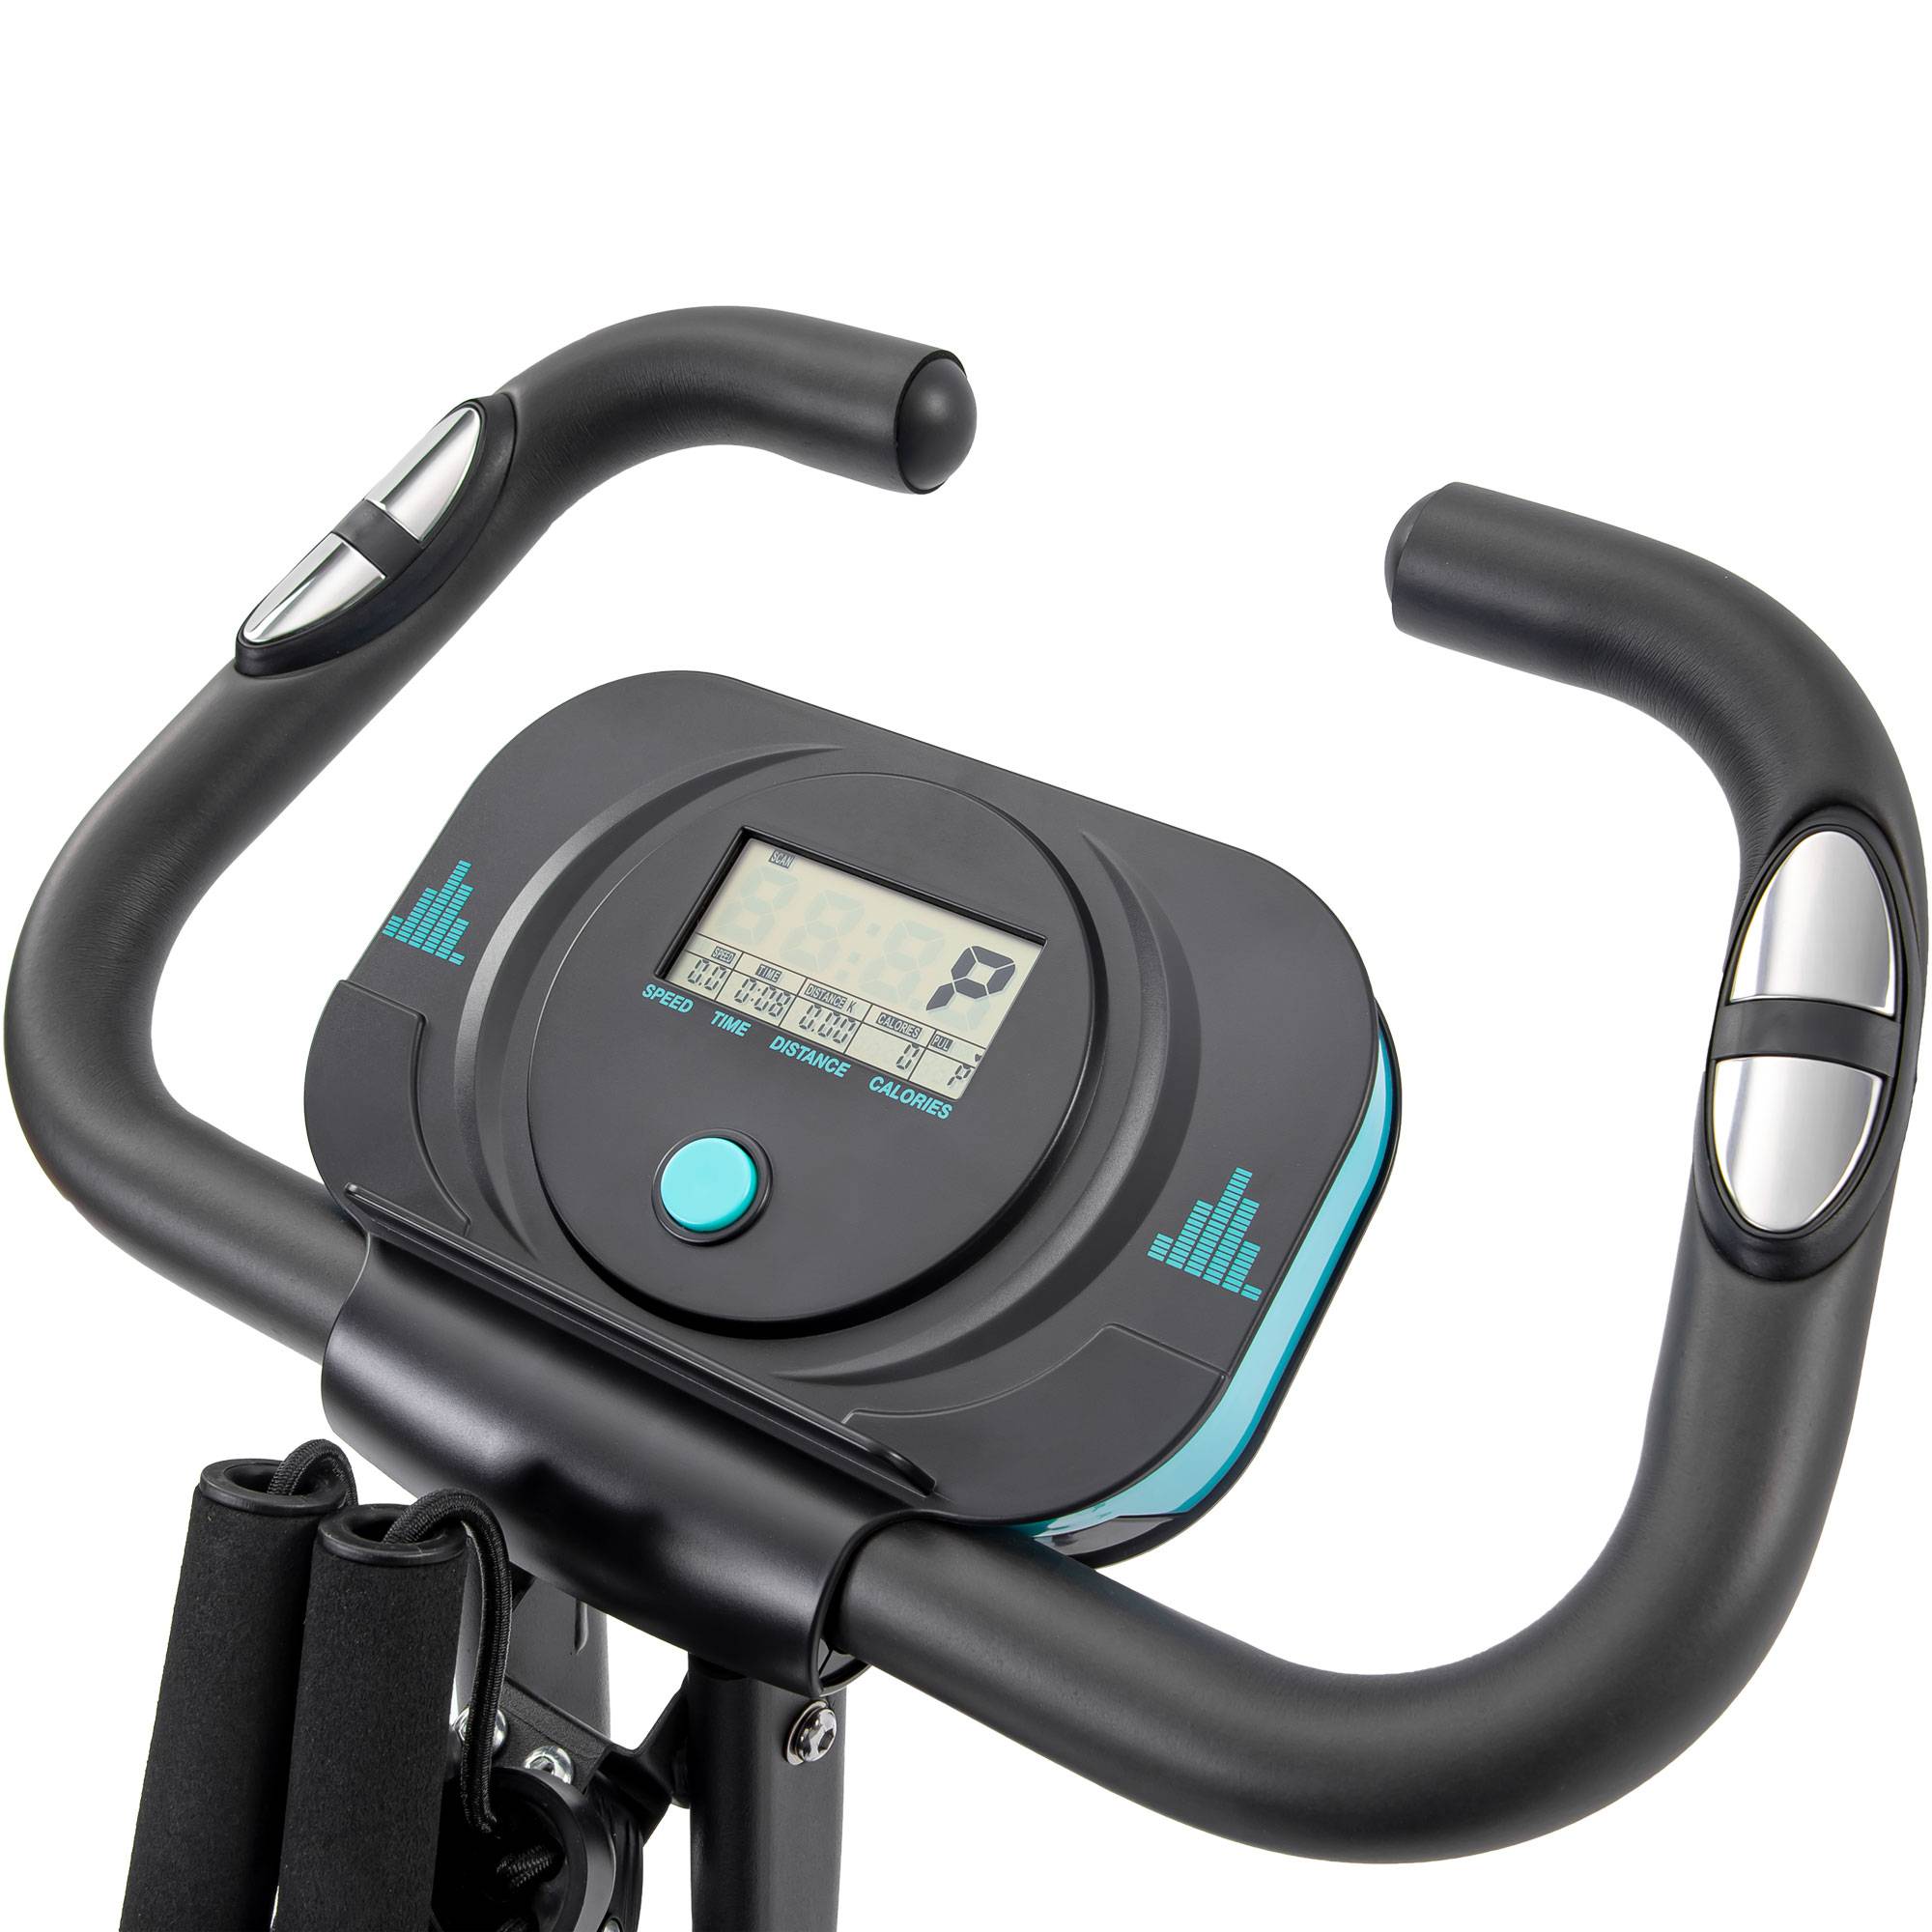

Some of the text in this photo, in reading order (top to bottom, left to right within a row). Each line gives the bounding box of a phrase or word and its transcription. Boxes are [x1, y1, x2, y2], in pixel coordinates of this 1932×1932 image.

[771, 850, 793, 867] SCAN
[713, 948, 735, 963] SPEED
[756, 965, 780, 981] TIME
[641, 983, 695, 1013] SPEED
[806, 983, 846, 1008] DISTANCE
[710, 1010, 752, 1037] TIME
[877, 1013, 921, 1038] CALORIES
[931, 1034, 952, 1050] PUL
[769, 1035, 851, 1078] DISTANCE
[868, 1075, 952, 1120] CALORIES
